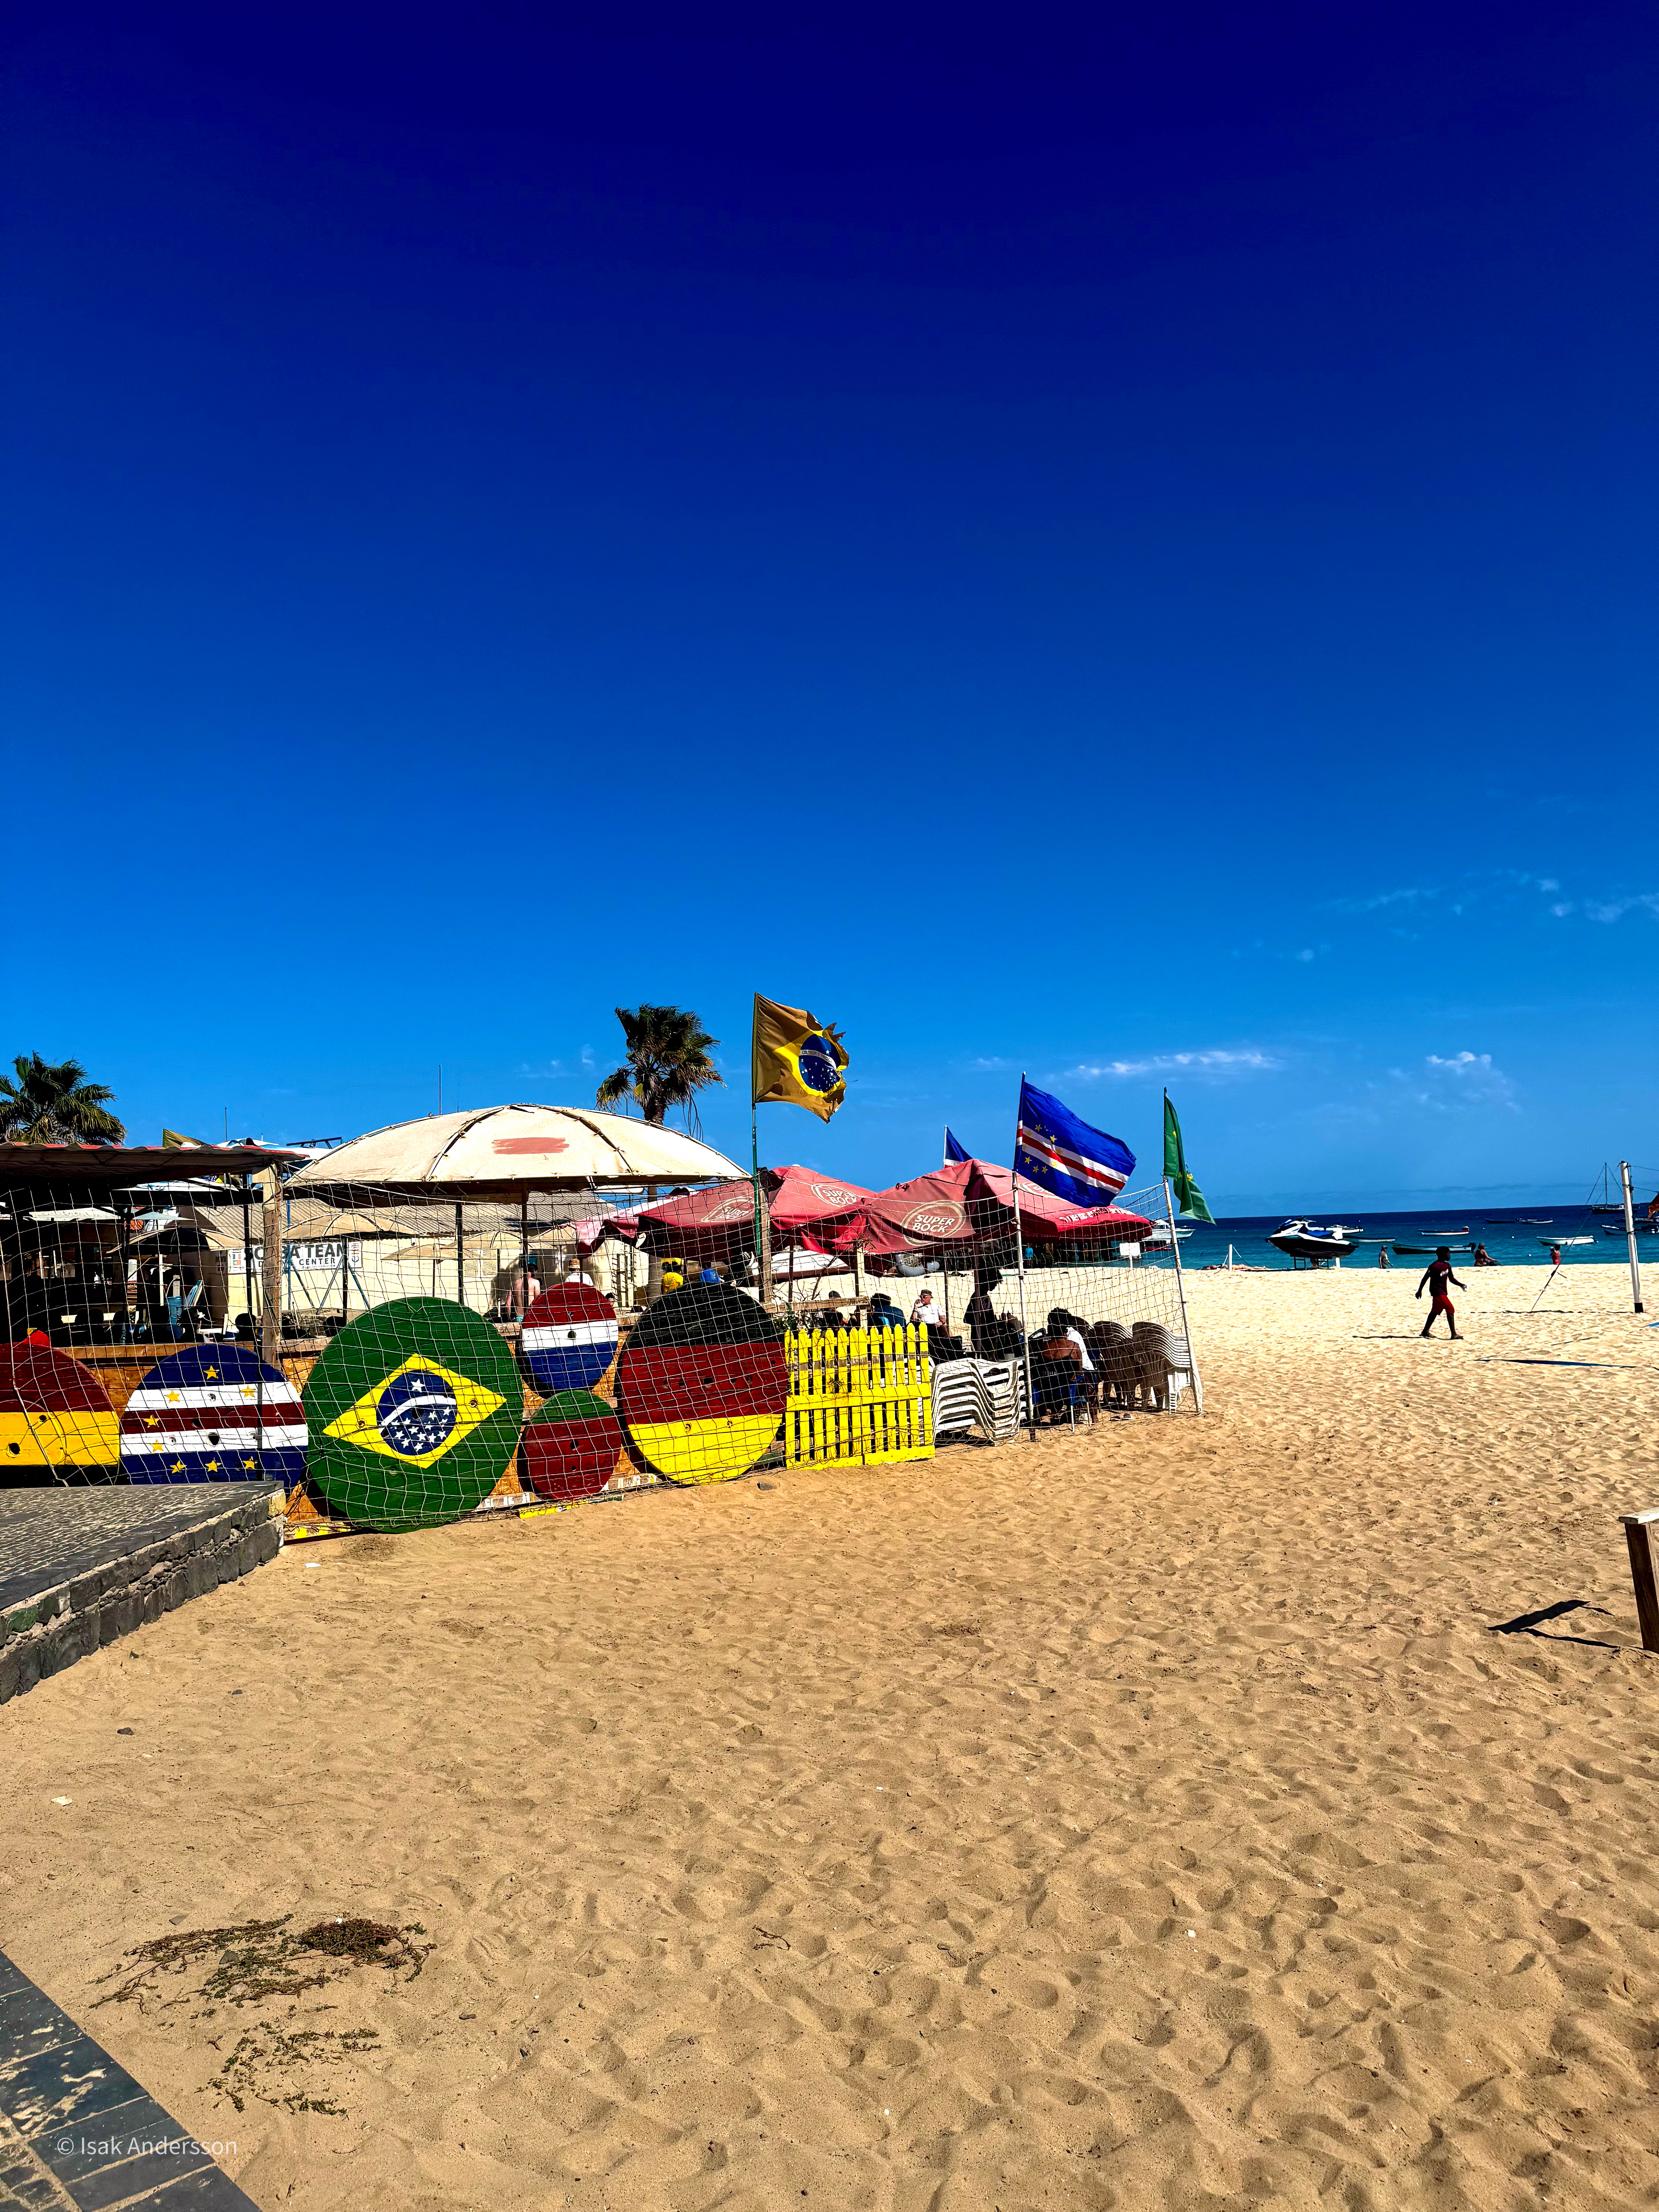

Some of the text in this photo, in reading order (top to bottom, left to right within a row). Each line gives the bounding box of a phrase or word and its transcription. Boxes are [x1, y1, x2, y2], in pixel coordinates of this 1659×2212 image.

[822, 1190, 857, 1198] SUPER
[914, 1214, 955, 1225] SUPER
[912, 1223, 949, 1233] BOCK
